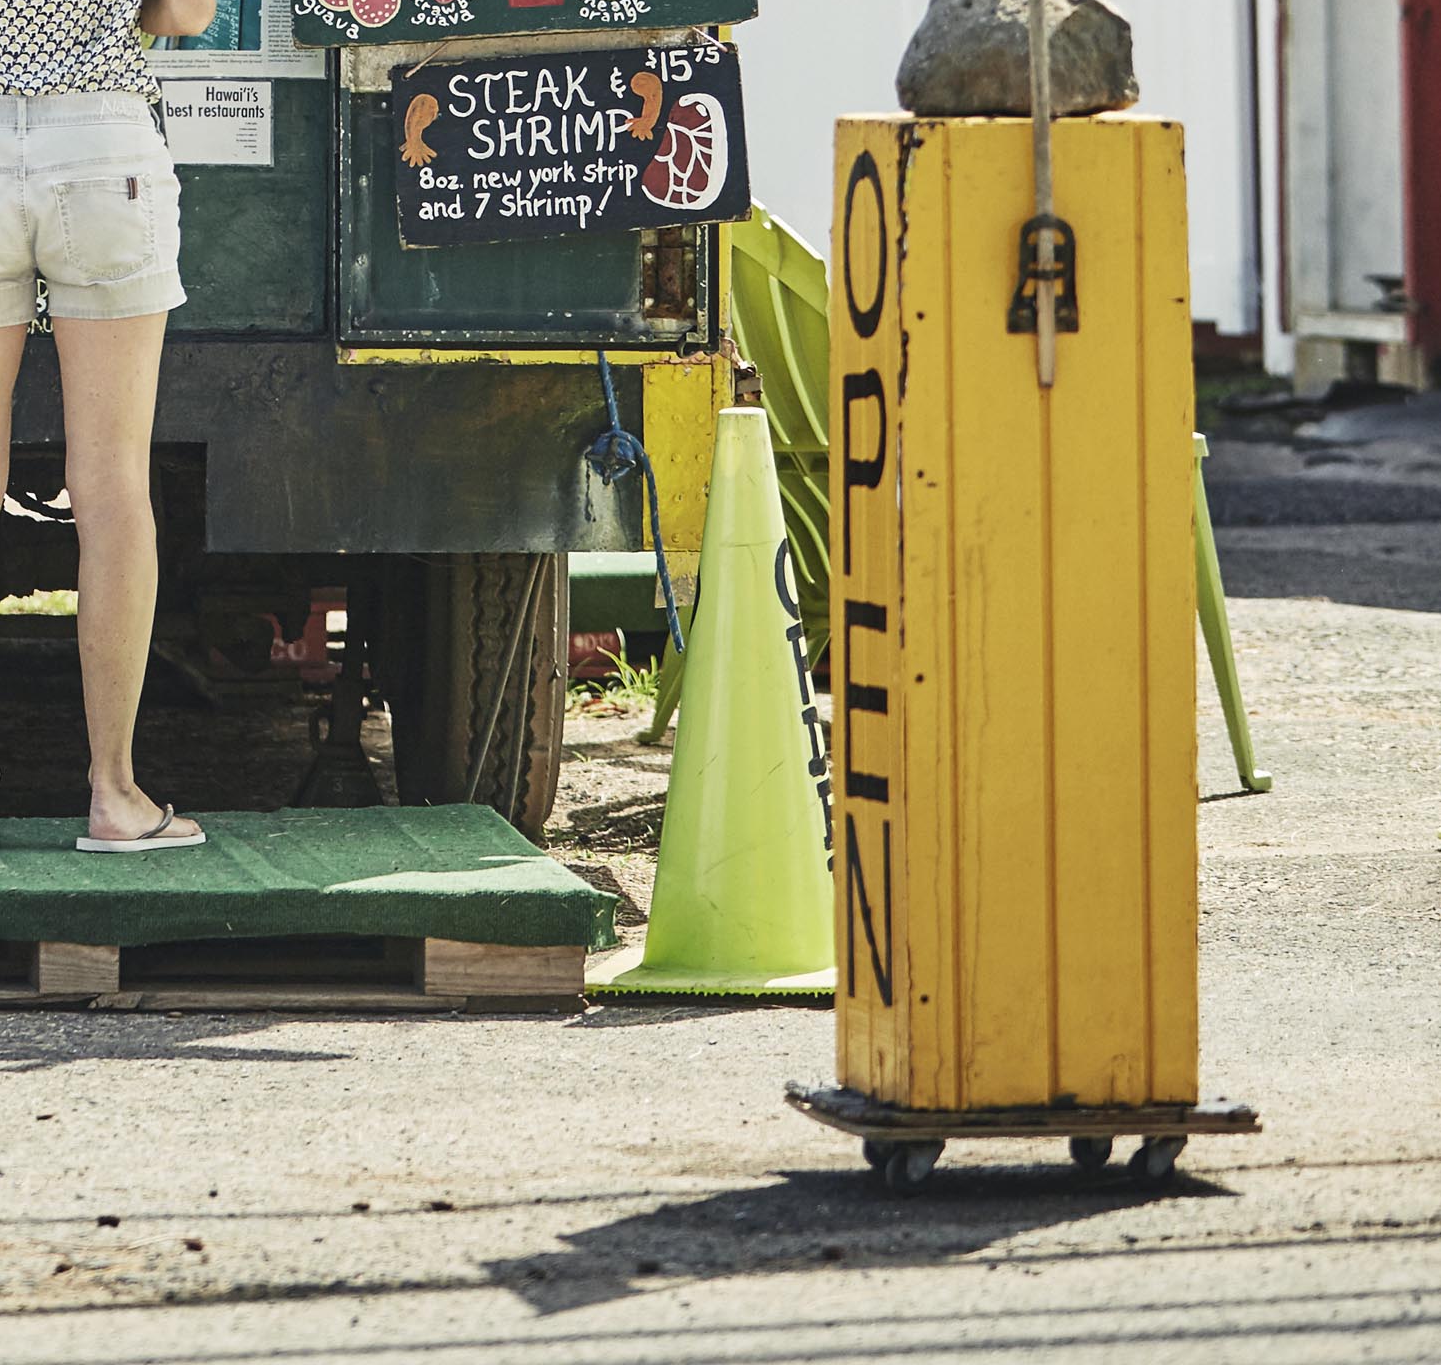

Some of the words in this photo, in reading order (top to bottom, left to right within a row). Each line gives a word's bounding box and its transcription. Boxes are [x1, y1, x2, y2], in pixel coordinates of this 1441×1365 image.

[410, 6, 475, 27] guava
[448, 65, 595, 117] STEAK
[610, 67, 626, 98] &
[166, 101, 192, 117] best
[198, 104, 264, 118] restaurants
[468, 108, 634, 161] SHRIMP
[473, 168, 521, 190] new
[528, 161, 575, 197] york
[583, 161, 637, 197] strip
[418, 195, 464, 221] and
[475, 193, 494, 219] 7
[840, 149, 893, 1008] OPEN
